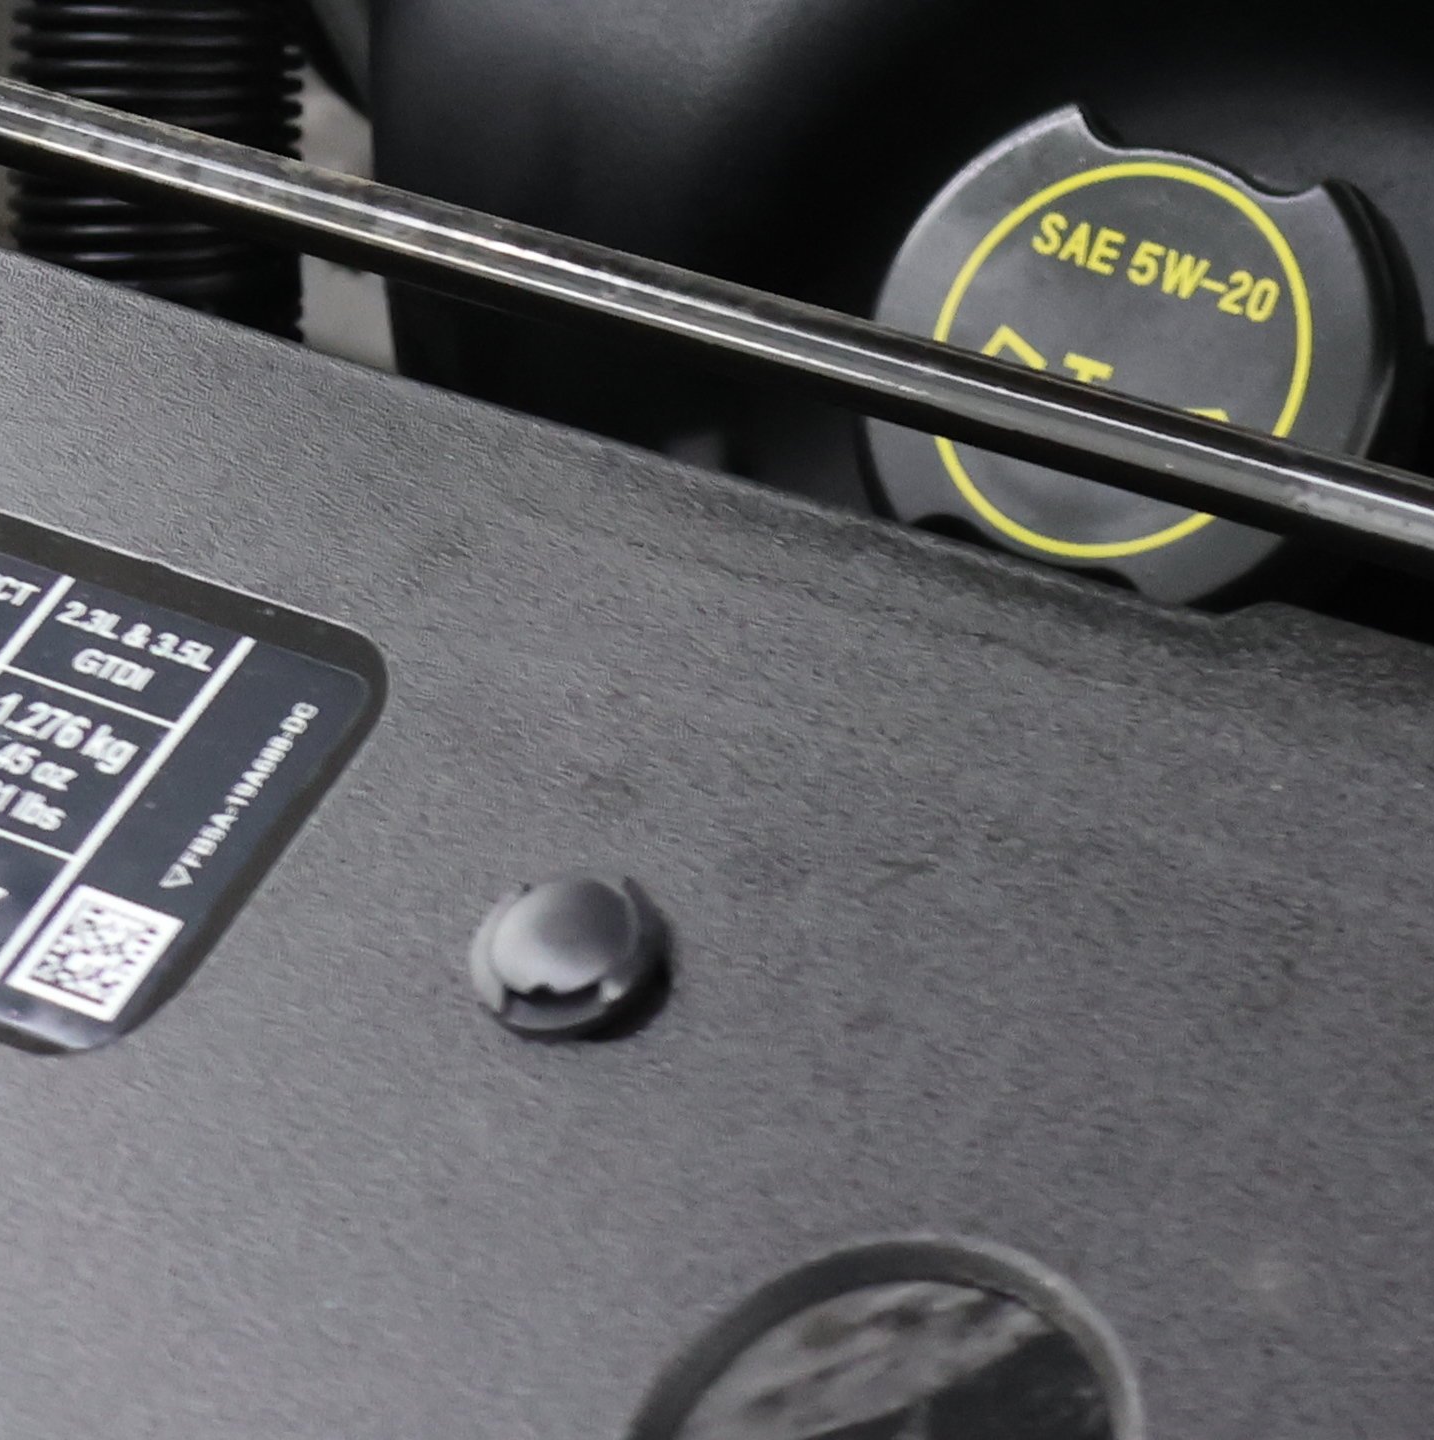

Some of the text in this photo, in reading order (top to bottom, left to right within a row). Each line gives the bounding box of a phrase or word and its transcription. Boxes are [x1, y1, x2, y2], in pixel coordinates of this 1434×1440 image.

[1031, 211, 1280, 324] SAE 5W-20
[55, 601, 214, 672] 2.3L & 3.5L
[72, 648, 156, 692] GTDI
[80, 724, 139, 775] kg
[31, 762, 79, 791] oz
[9, 790, 67, 831] lbs
